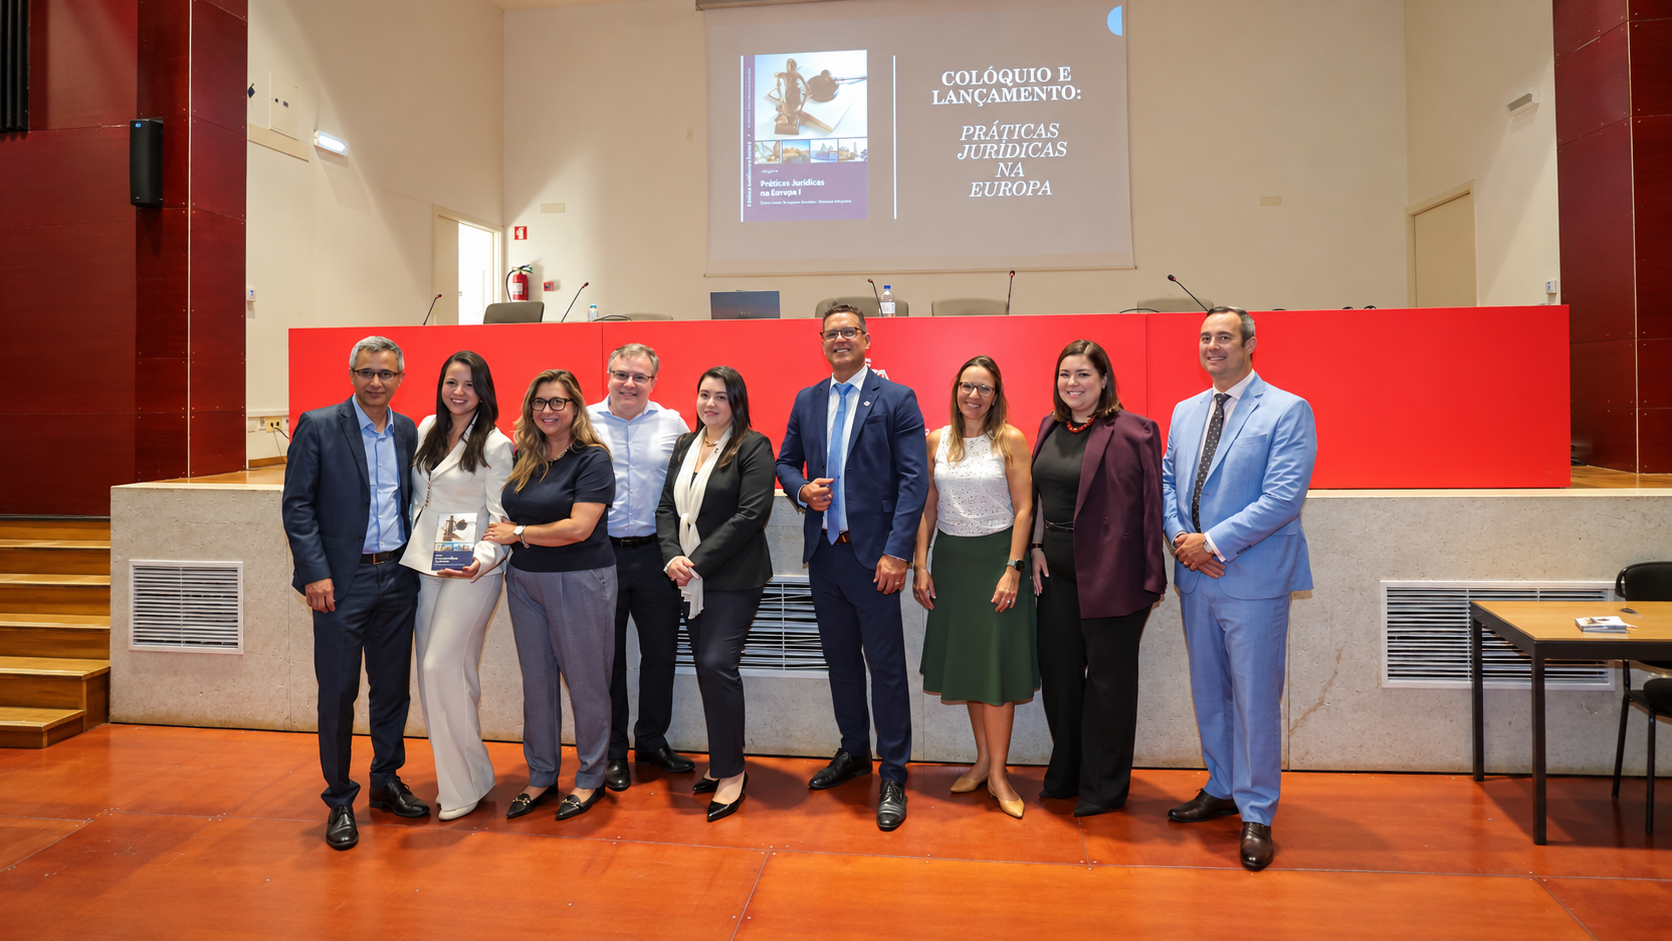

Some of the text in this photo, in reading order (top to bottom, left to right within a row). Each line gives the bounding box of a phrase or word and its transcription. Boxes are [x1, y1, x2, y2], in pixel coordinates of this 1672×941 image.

[941, 65, 1072, 86] COLÓQUIO E
[931, 85, 1082, 107] LANÇAMENTO:
[959, 120, 1060, 141] PRÁTICAS
[957, 140, 1067, 160] JURÍDICAS
[995, 161, 1025, 178] NA
[791, 178, 825, 187] Jurídicas
[968, 180, 1053, 198] EUROPA
